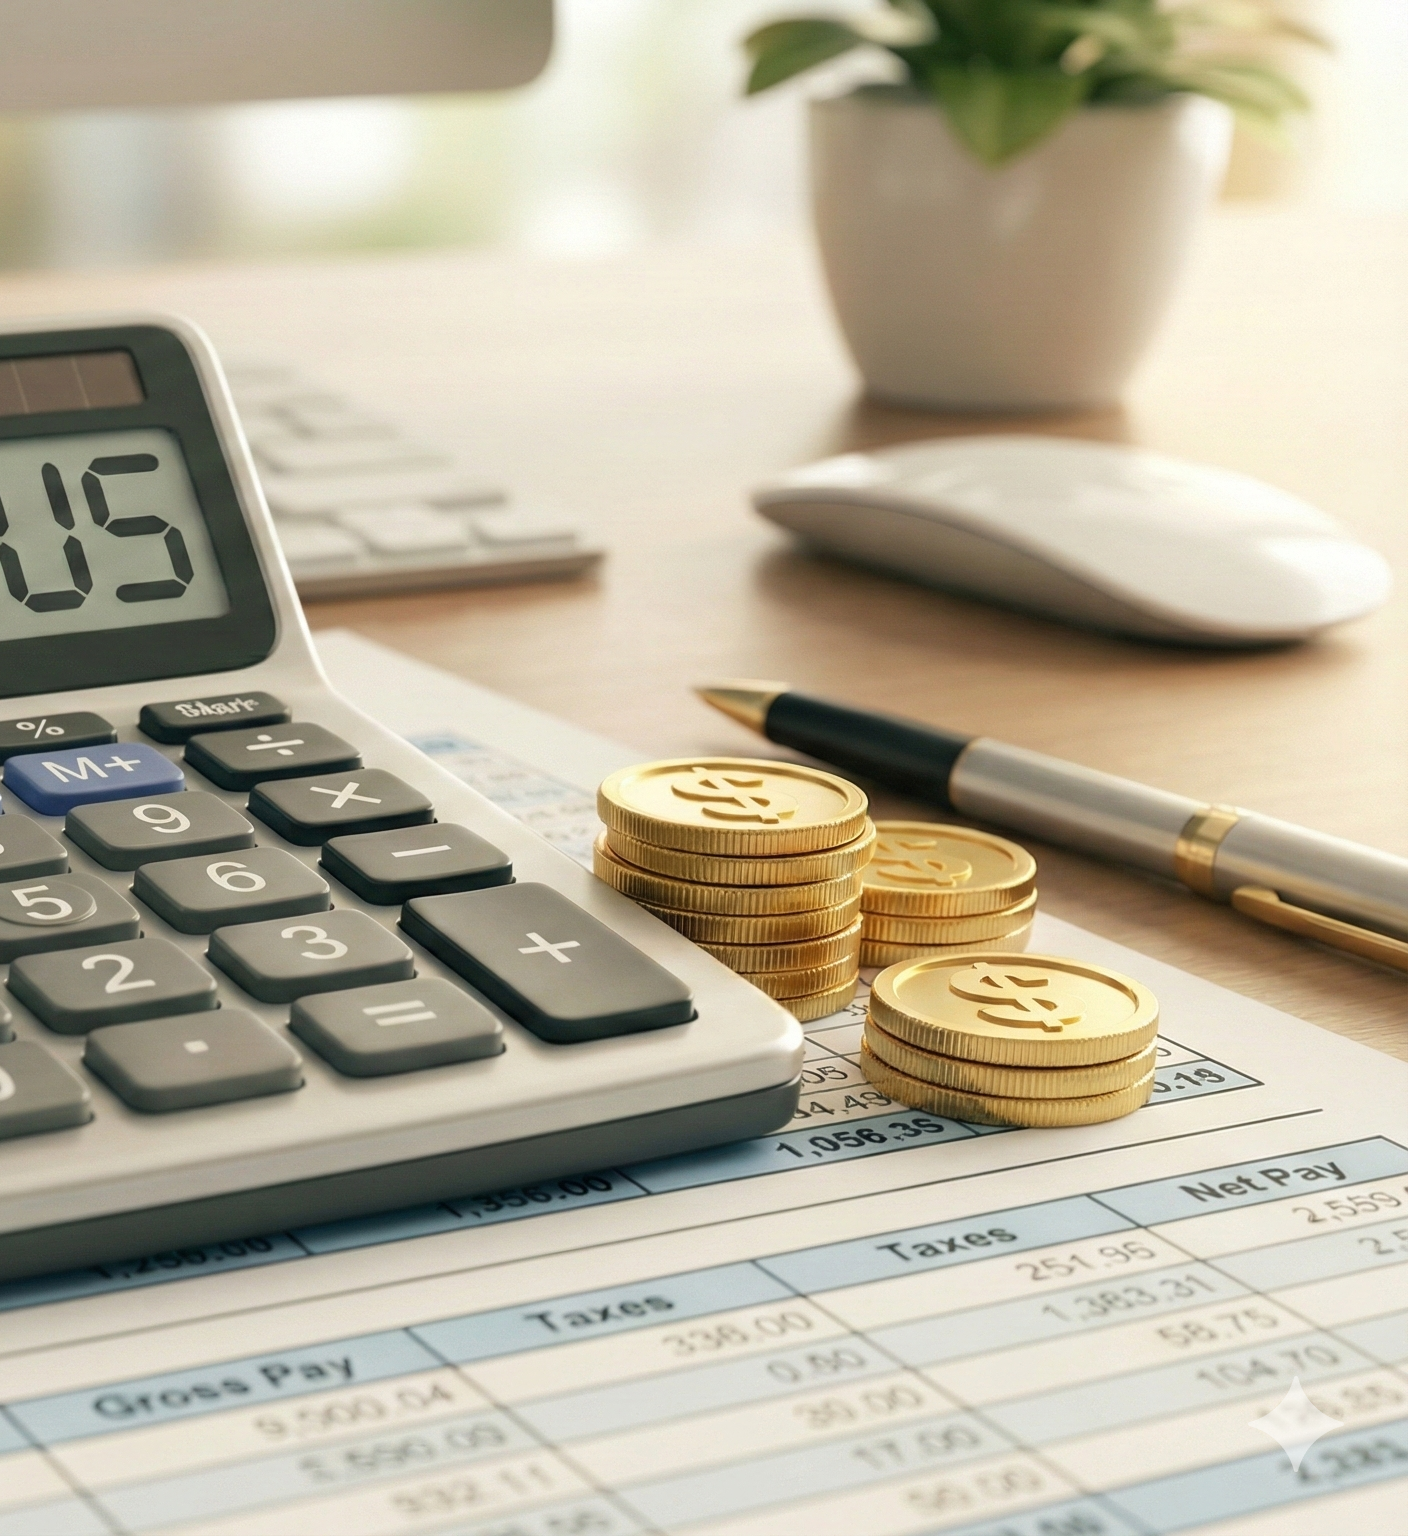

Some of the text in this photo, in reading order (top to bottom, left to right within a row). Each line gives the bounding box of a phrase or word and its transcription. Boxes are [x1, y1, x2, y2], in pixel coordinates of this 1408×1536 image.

[16, 718, 65, 739] %
[41, 755, 142, 783] M+
[132, 804, 191, 834] 9
[206, 861, 266, 893] 6
[11, 884, 73, 921] 5
[280, 924, 349, 960] 3
[516, 931, 582, 963] +
[81, 953, 157, 994] 2
[1177, 1161, 1347, 1203] Net Pay
[875, 1227, 1018, 1263] Taxes
[525, 1295, 676, 1335] Taxes
[92, 1357, 355, 1420] Gross Pay
